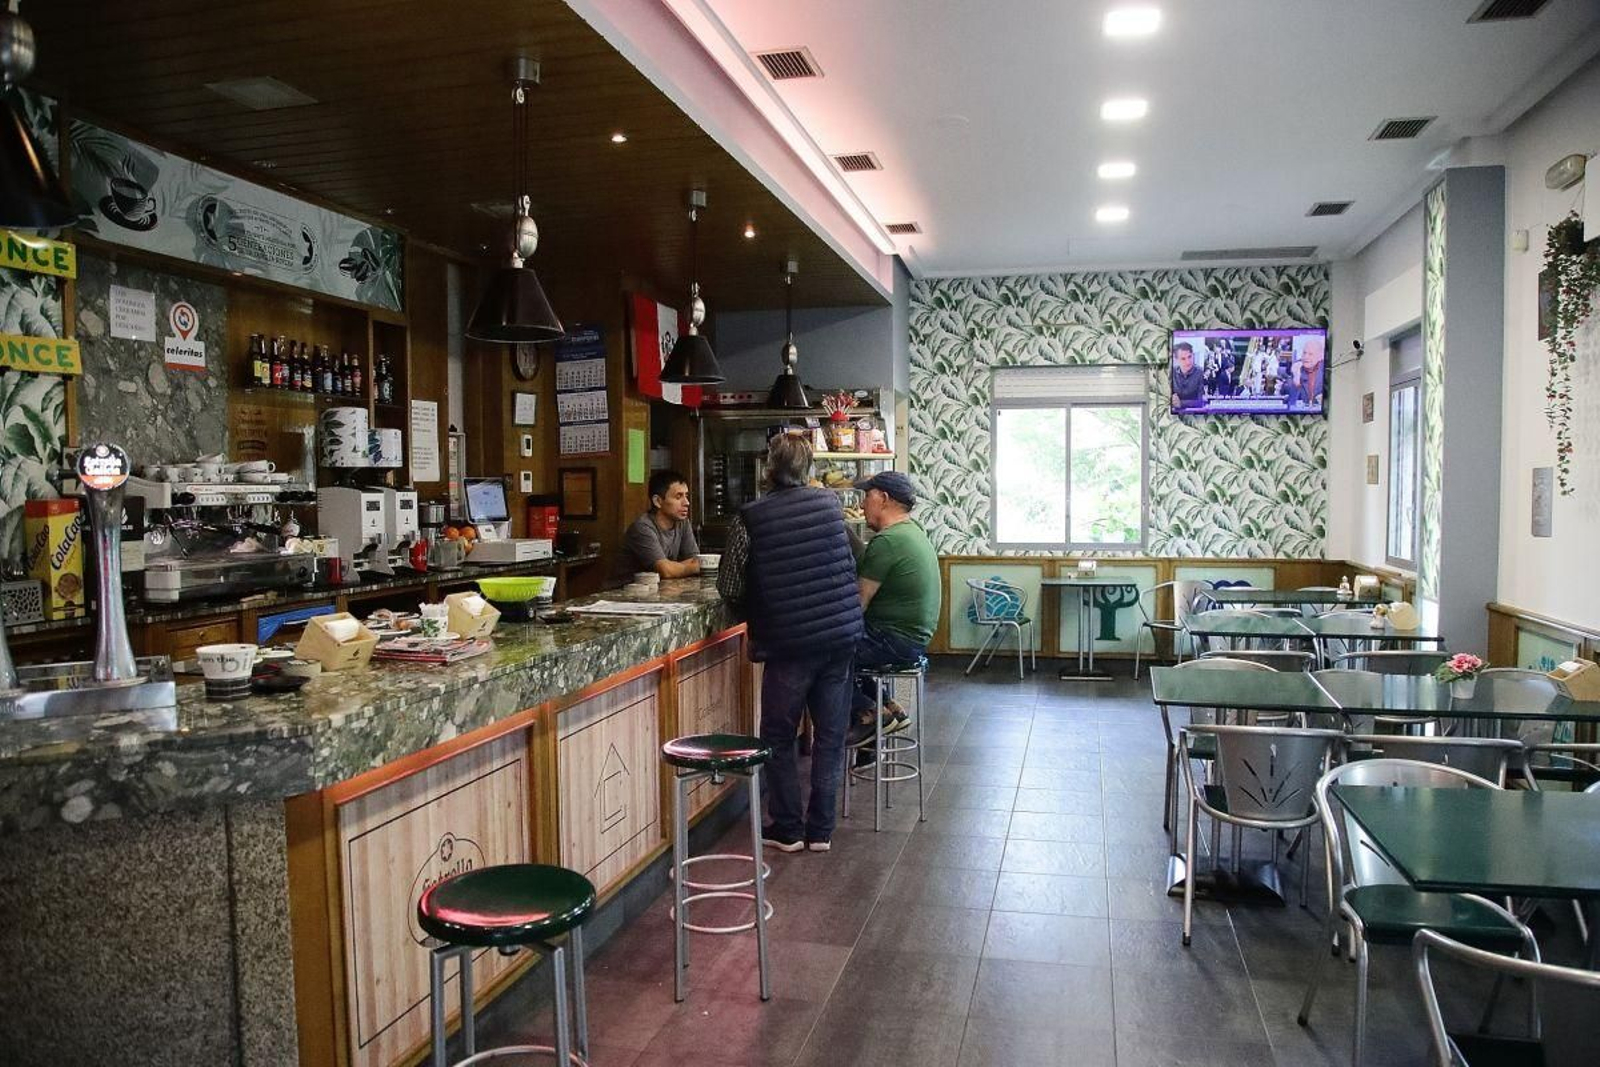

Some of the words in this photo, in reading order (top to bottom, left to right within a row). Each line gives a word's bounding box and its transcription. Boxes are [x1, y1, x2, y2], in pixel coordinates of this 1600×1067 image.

[0, 238, 69, 271] NCE
[228, 235, 237, 251] 5
[0, 341, 74, 368] NCE
[166, 346, 204, 359] celeritas
[51, 514, 82, 572] ColaCao
